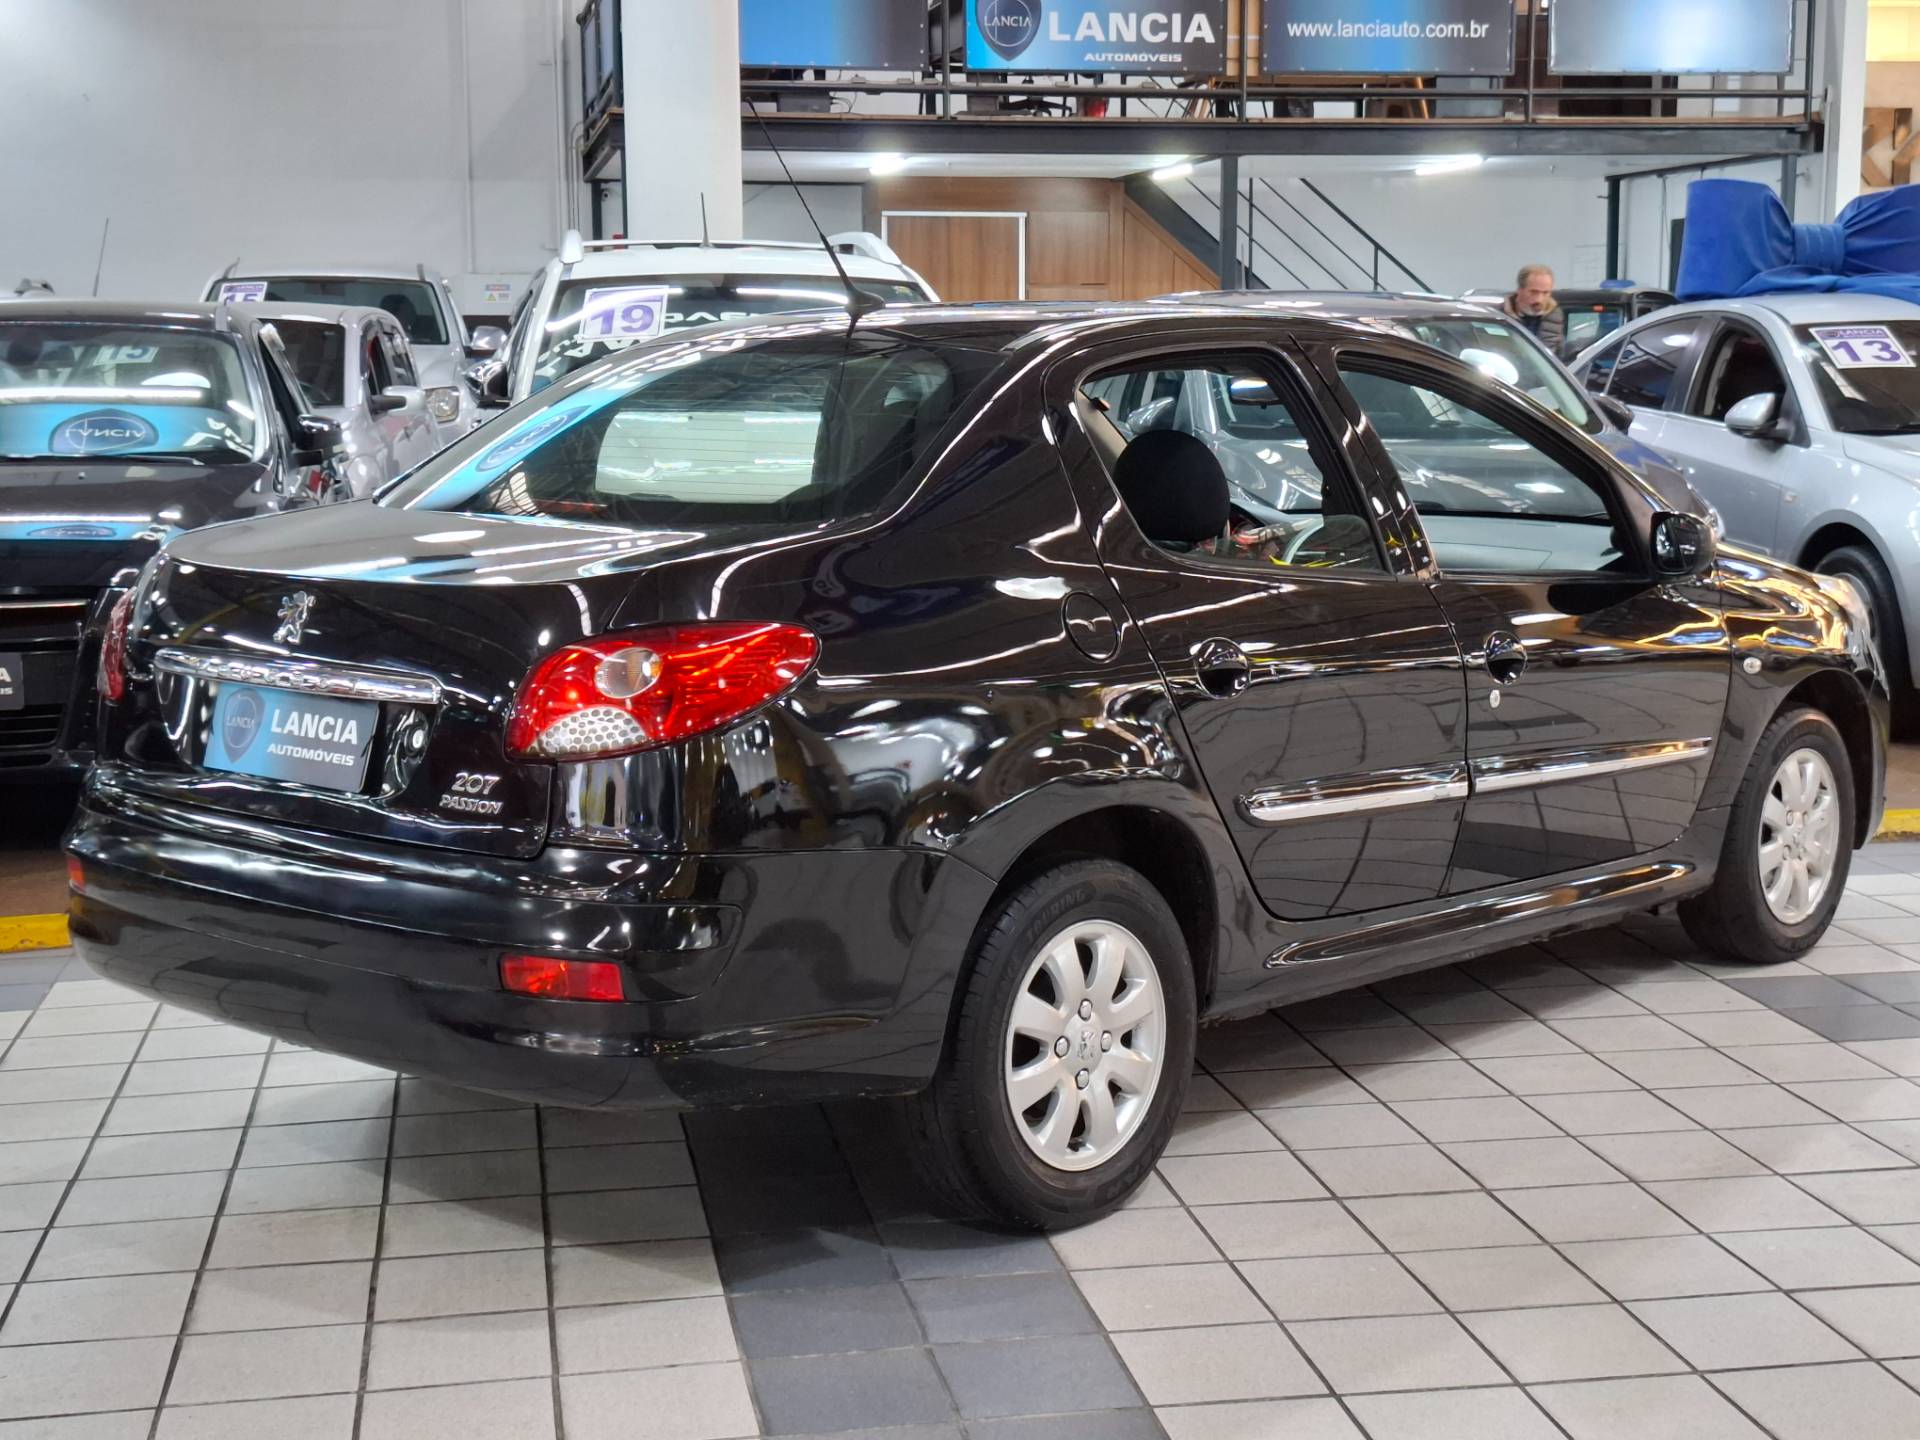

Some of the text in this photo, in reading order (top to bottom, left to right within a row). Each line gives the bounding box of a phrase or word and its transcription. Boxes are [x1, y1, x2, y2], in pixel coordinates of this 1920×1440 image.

[984, 15, 1032, 27] LANCIA
[1048, 11, 1216, 44] LANCIA
[1287, 19, 1489, 38] www.lanciauto.com.br
[1084, 52, 1183, 63] AUTOMÓVEIS
[591, 304, 655, 335] 19
[1832, 341, 1900, 361] 13
[225, 715, 256, 730] LANCIA
[270, 708, 358, 745] LANCIA
[267, 743, 355, 766] AUTOMÓVEIS
[451, 772, 501, 795] 207
[439, 794, 503, 815] PASSION
